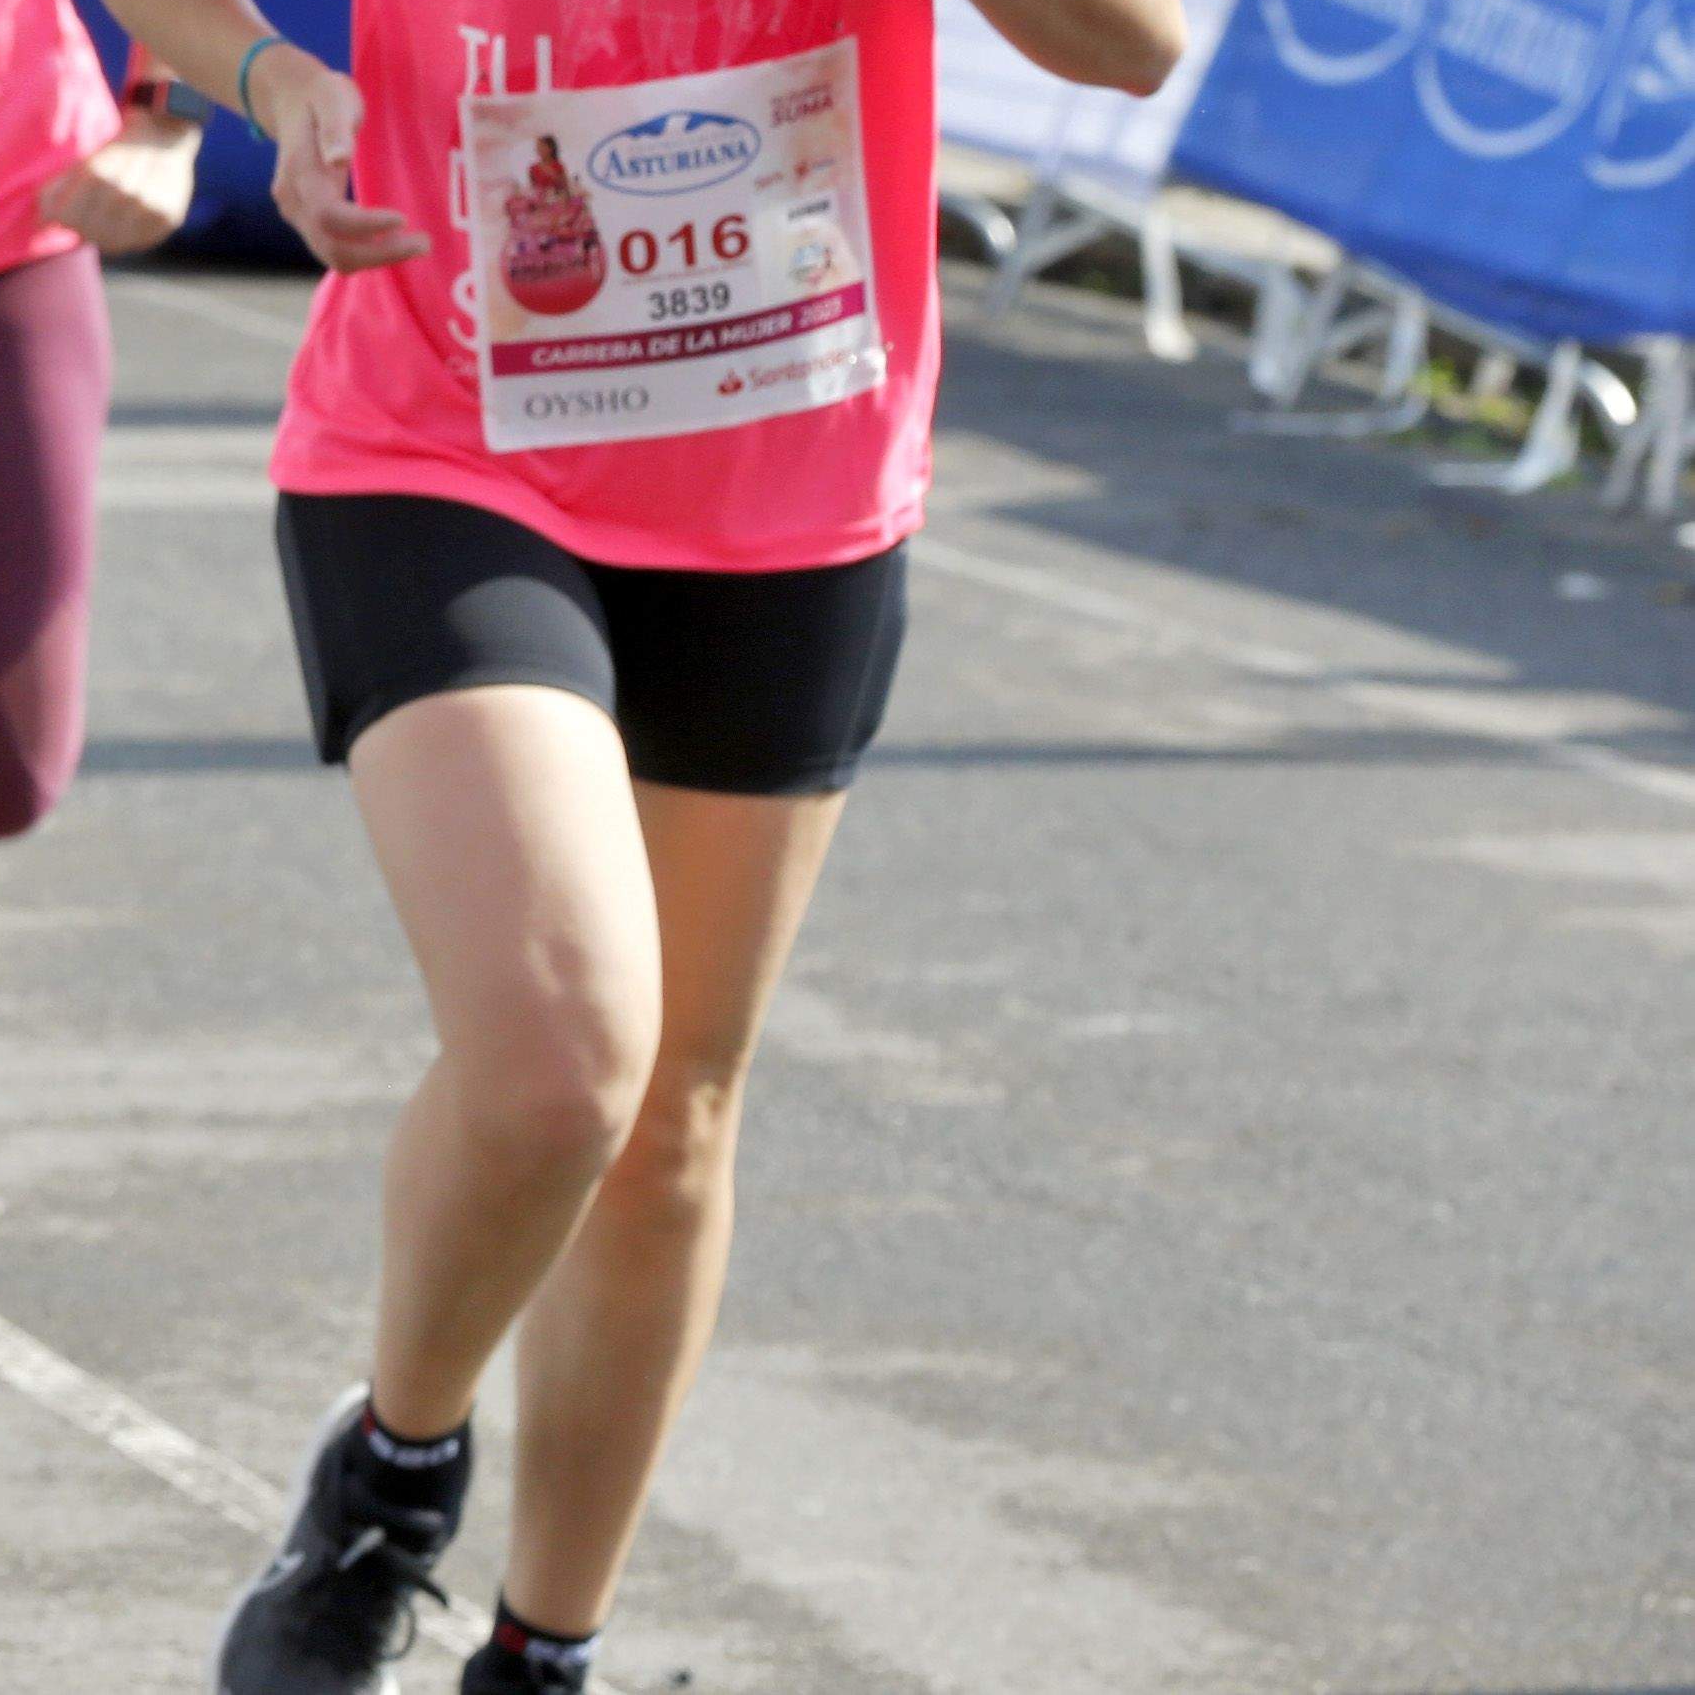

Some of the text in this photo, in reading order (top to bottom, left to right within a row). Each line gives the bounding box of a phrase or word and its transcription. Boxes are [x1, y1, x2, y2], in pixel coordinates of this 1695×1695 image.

[618, 213, 751, 275] 016
[648, 280, 732, 322] 3839
[647, 335, 682, 357] DE
[684, 331, 716, 354] LA
[523, 384, 650, 421] OYSHO
